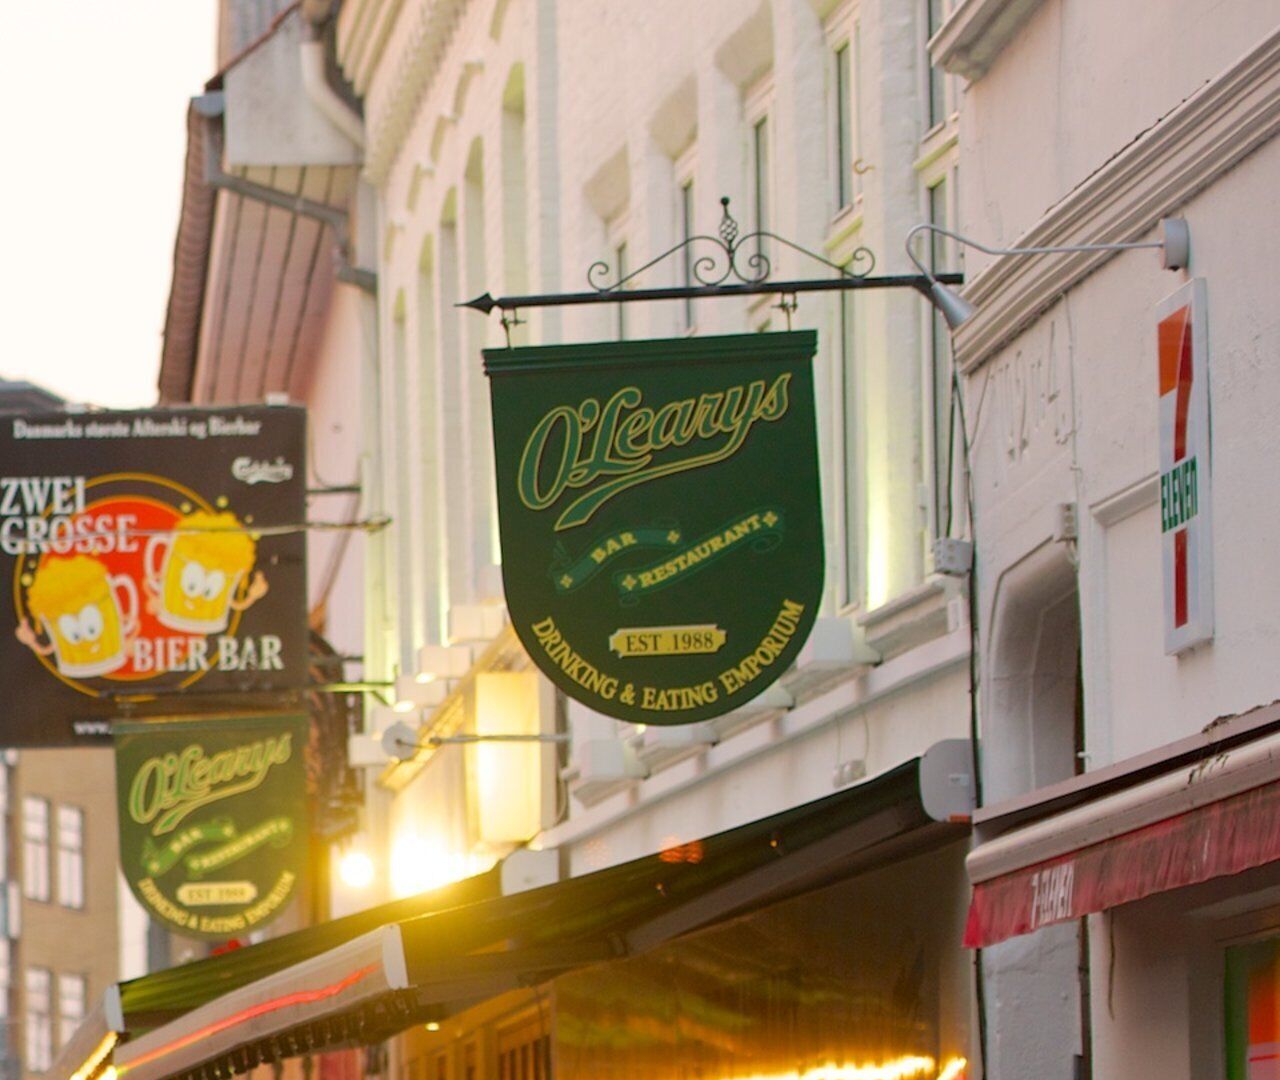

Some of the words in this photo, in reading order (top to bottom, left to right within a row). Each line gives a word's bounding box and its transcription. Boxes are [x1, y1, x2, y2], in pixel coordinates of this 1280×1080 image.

[0, 477, 86, 515] ZWEI
[0, 515, 140, 555] GROSSE
[591, 531, 637, 564] BAR
[639, 514, 762, 589] RESTAURANT
[132, 637, 210, 673] BIER
[218, 634, 284, 671] BAR
[532, 616, 620, 698] DRINKING
[621, 687, 634, 706] &
[642, 686, 718, 711] EATING
[722, 598, 805, 694] EMPORIUM
[626, 635, 661, 652] EST
